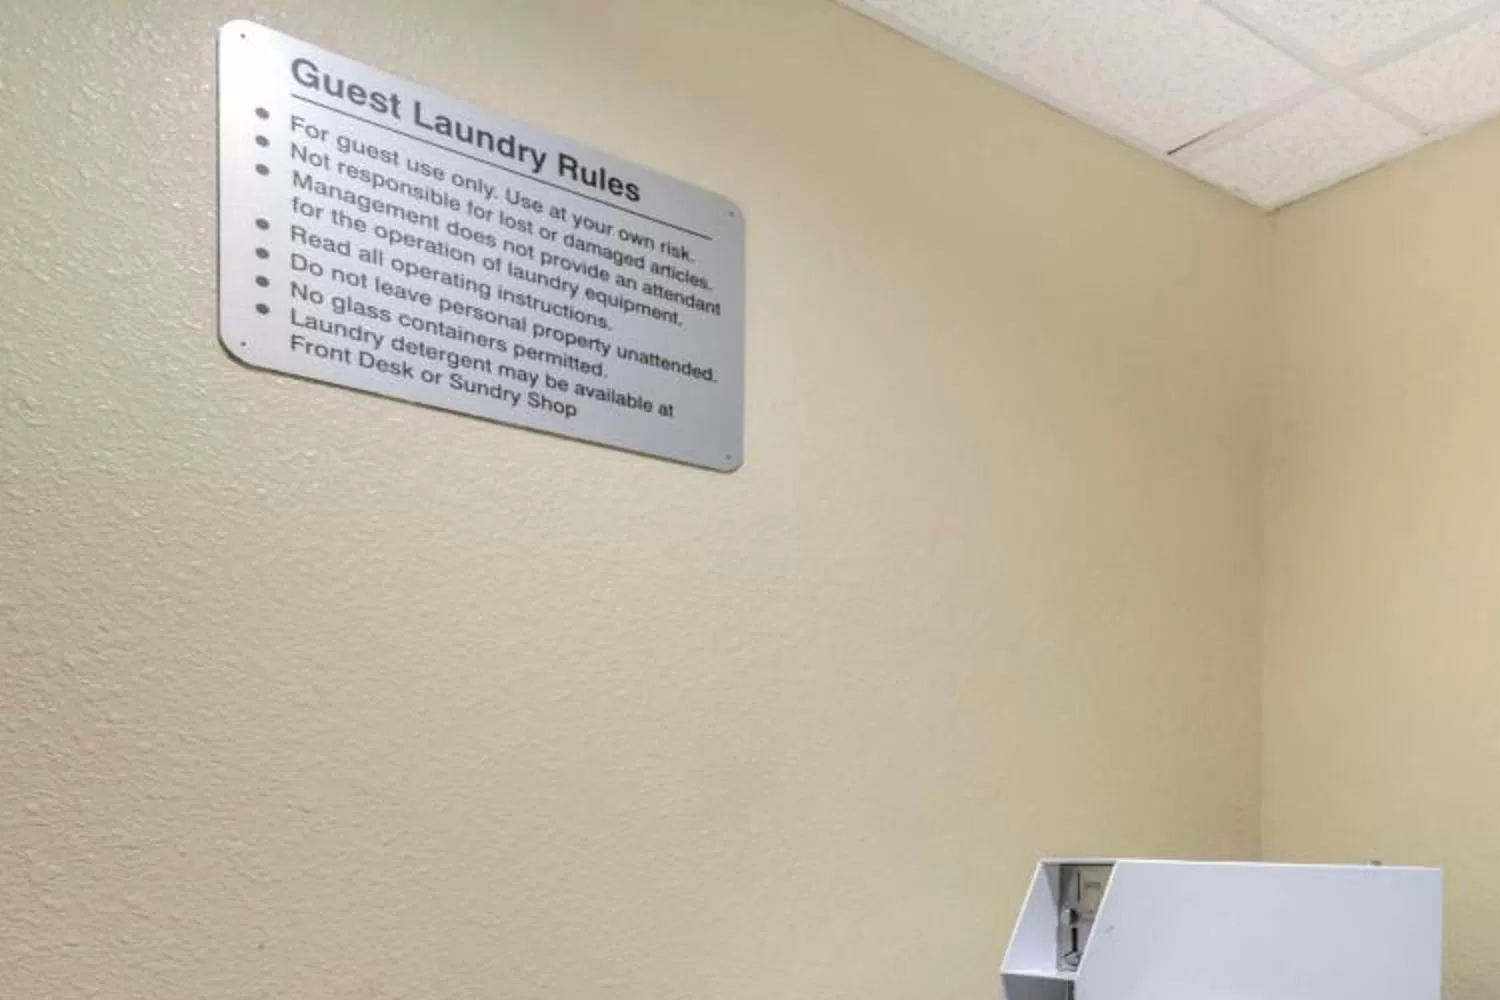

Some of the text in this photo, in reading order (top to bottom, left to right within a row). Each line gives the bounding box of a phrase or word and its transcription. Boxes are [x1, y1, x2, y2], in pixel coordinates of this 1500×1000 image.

[291, 57, 640, 202] Guest Laundry Rules
[291, 115, 695, 262] For guest use only. Use at your own risk.
[291, 143, 712, 291] Not responsible for lost or damaged articles.
[291, 225, 612, 330] Read all operating instructions.
[292, 170, 720, 316] Management does not provide an attendant
[292, 196, 683, 326] for the operation of laundry equipment.
[291, 253, 718, 383] Do not leave personal property unattended.
[291, 281, 608, 378] No glass containers permitted.
[291, 308, 674, 418] Laundry detergent may be available at
[291, 334, 577, 419] Front Desk or Sundry Shop
